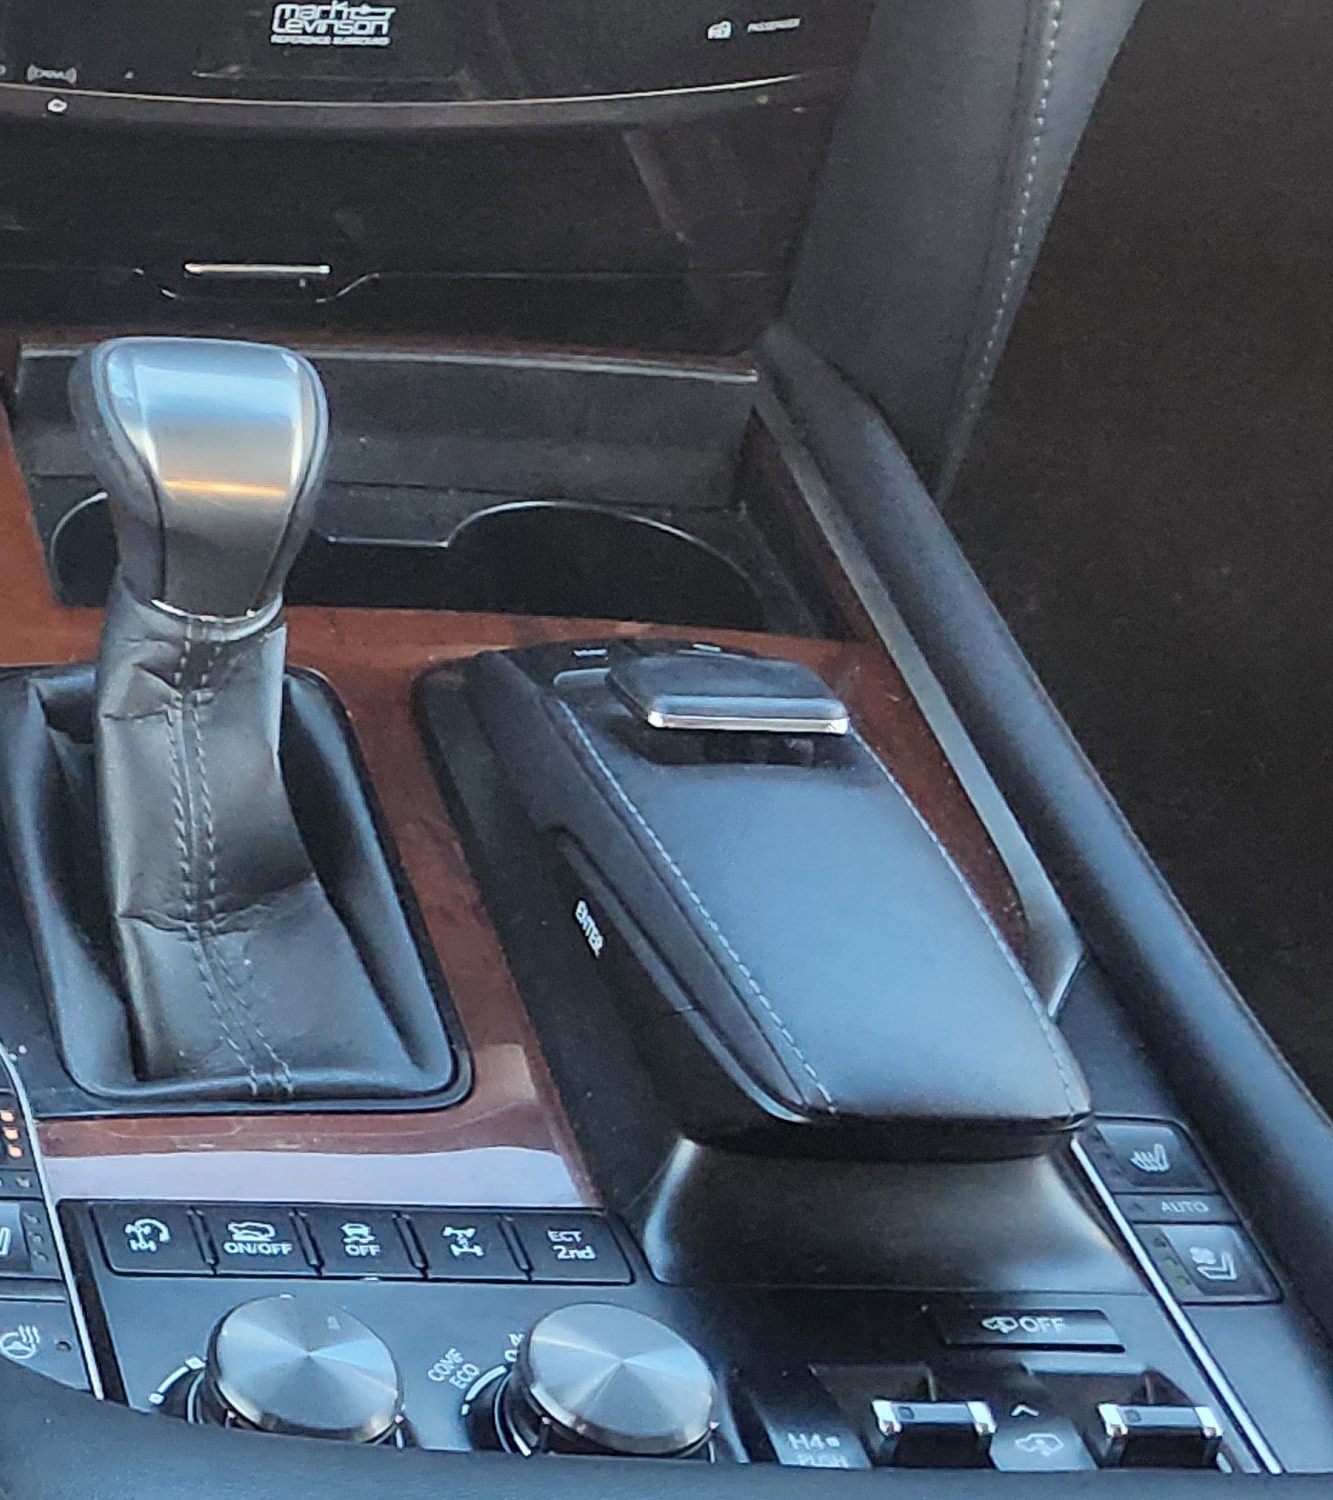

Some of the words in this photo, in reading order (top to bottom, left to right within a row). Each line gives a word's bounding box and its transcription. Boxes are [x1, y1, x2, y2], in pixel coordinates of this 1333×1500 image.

[1161, 1200, 1209, 1213] AUTO
[547, 1230, 582, 1242] ECT
[224, 1242, 293, 1255] ON/OFF
[345, 1244, 381, 1256] OFF
[552, 1245, 596, 1259] 2nd
[1020, 1317, 1066, 1332] OFF
[449, 1363, 480, 1390] ECO
